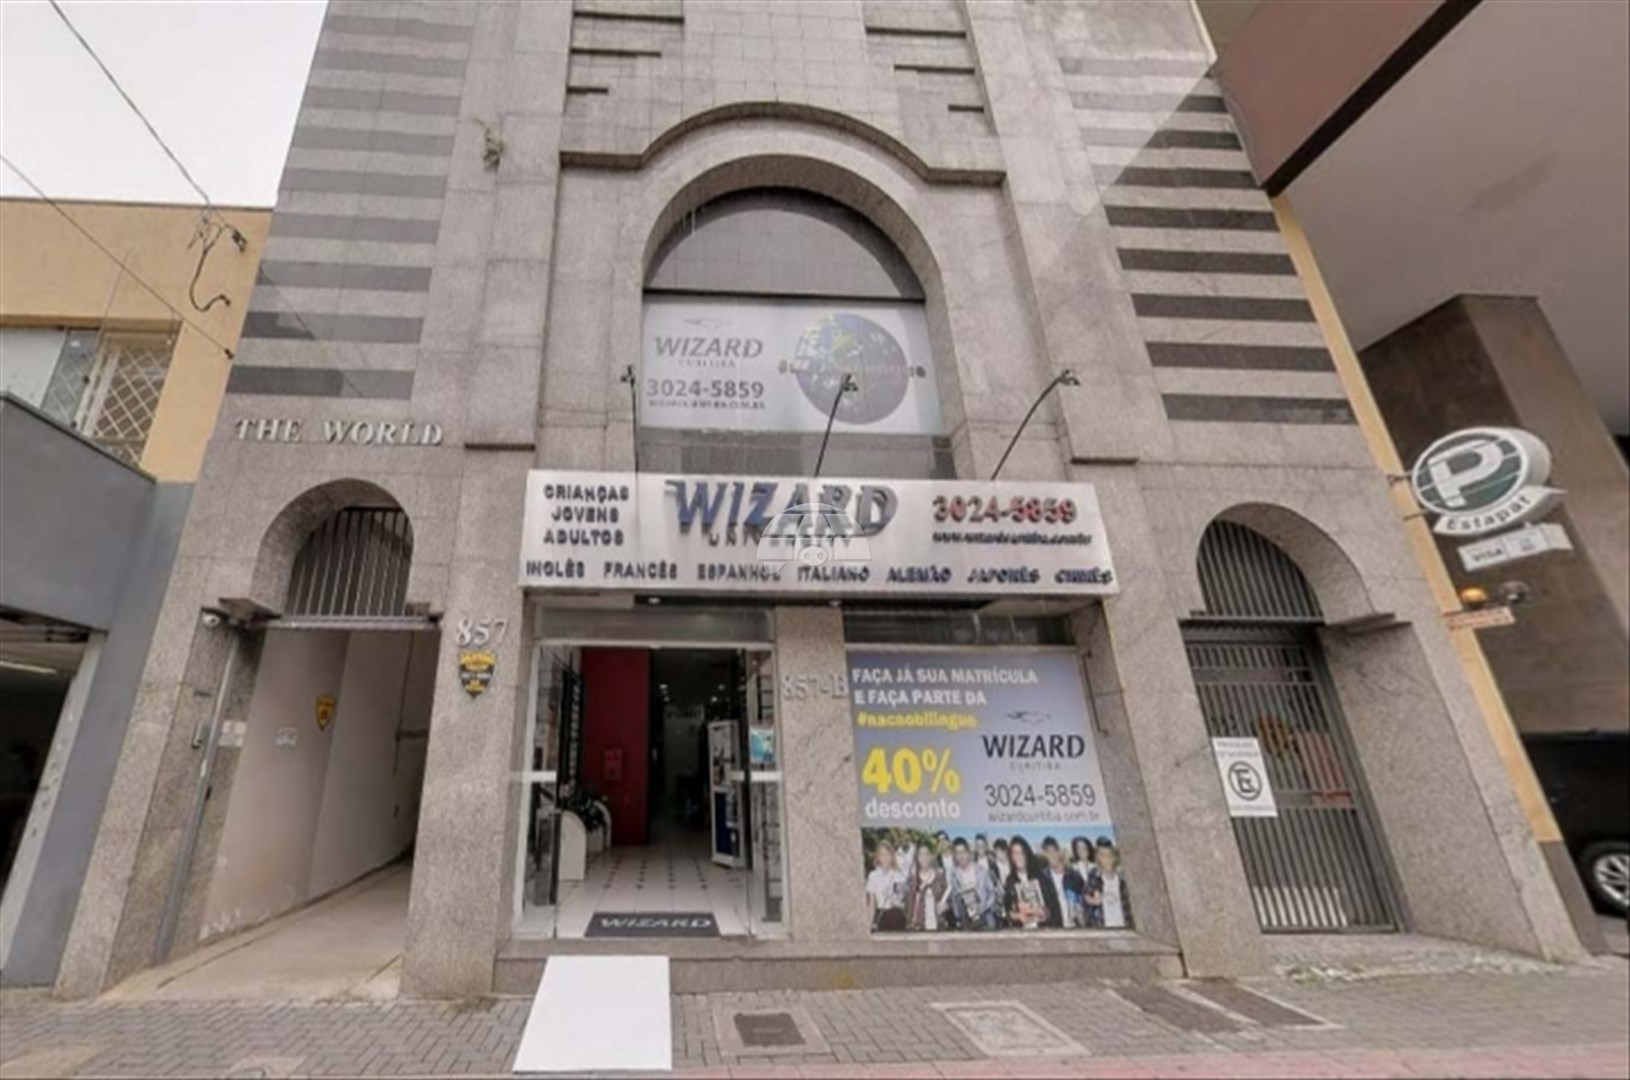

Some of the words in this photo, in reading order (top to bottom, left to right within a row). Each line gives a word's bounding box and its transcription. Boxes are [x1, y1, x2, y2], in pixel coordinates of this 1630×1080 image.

[654, 336, 763, 359] WIZARD
[646, 378, 764, 399] 3024-5859
[236, 418, 302, 441] THE
[323, 420, 443, 445] WORLD
[543, 484, 630, 503] CRIANÇAS
[551, 506, 619, 523] JOVENS
[664, 479, 898, 537] WIZARD
[932, 495, 1079, 524] 3024-5859
[1446, 494, 1532, 531] Estapar
[543, 529, 624, 546] ADULTOS
[526, 558, 585, 578] INGLÊS
[603, 560, 677, 579] FRANCÊS
[697, 563, 781, 582] ESPANHOL
[797, 565, 870, 583] ITALIANO
[886, 565, 952, 583] ALEMÃO
[967, 566, 1040, 584] JAPONÊS
[1054, 566, 1114, 585] CHINÊS
[456, 618, 507, 648] 857
[852, 668, 893, 687] FAÇA
[896, 663, 914, 684] JÁ
[916, 669, 949, 684] SUA
[951, 666, 1039, 685] MATRÍCULA
[854, 690, 866, 706] E
[867, 690, 909, 709] FAÇA
[912, 691, 962, 706] PARTE
[965, 691, 988, 706] DA
[982, 734, 1085, 758] WIZARD
[862, 747, 961, 795] 40%
[984, 783, 1096, 807] 3024-5859
[865, 797, 961, 819] desconto
[600, 917, 712, 929] WIZARD
